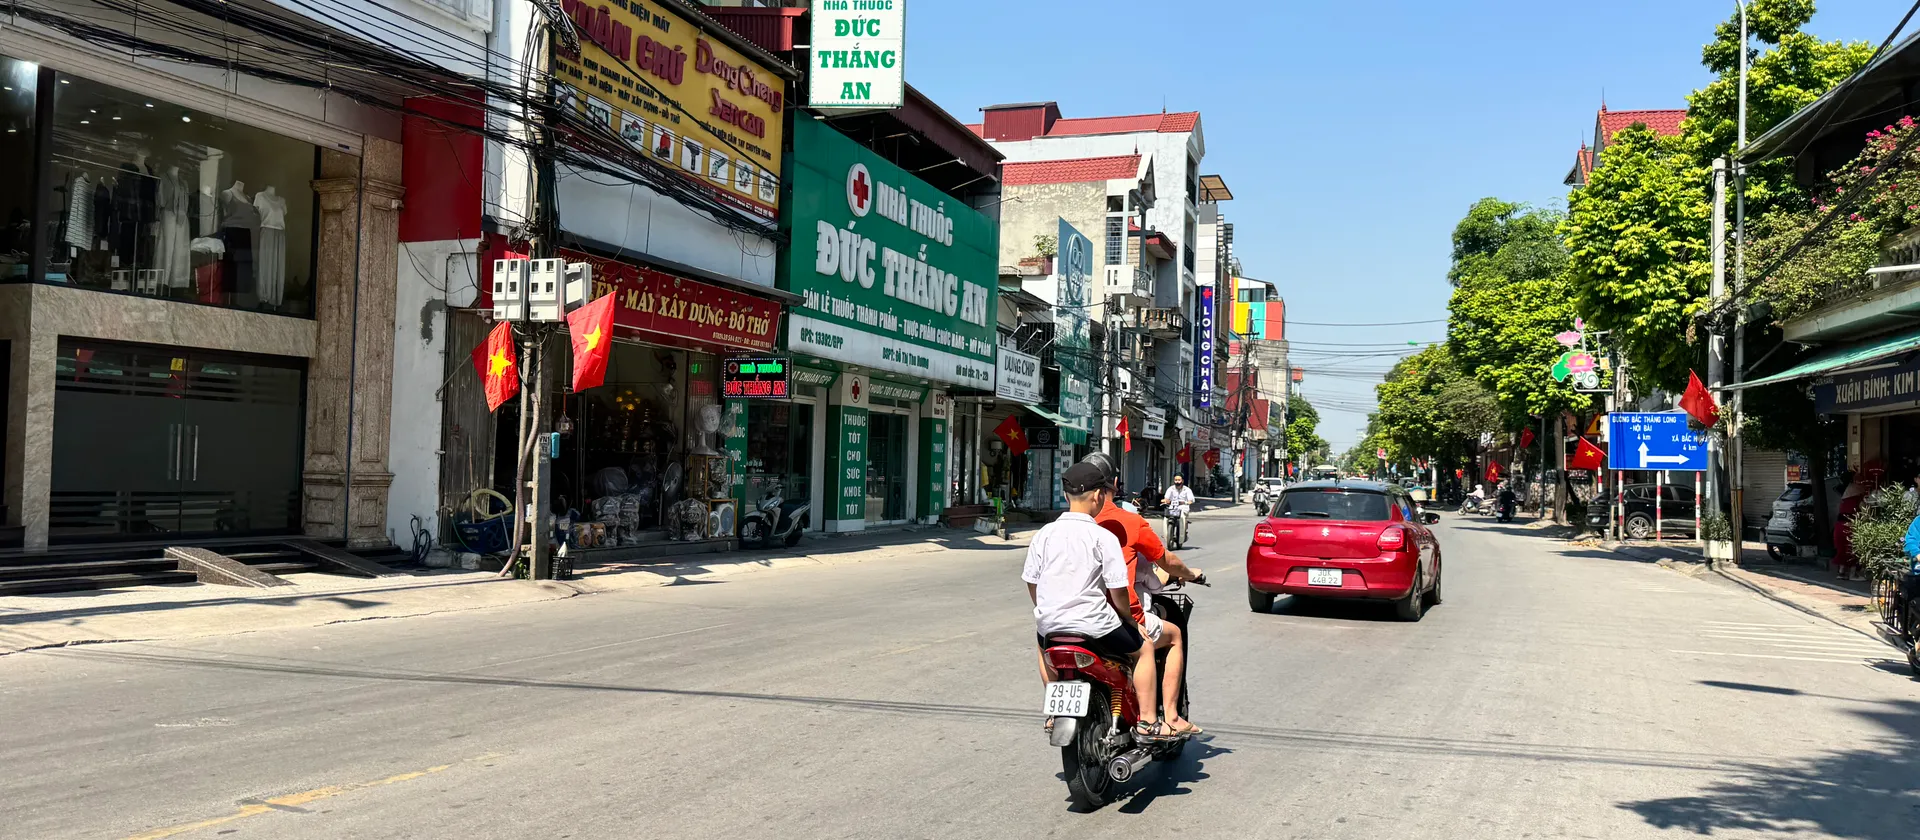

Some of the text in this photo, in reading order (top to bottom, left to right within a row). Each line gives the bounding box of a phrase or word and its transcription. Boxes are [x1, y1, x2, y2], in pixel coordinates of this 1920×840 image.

[630, 1, 651, 22] ĐIỆN
[652, 13, 670, 33] MÁY
[834, 14, 881, 37] ĐỨC
[636, 35, 688, 85] CHỨ
[818, 42, 896, 69] THẮNG
[583, 57, 599, 73] KINH
[621, 74, 635, 89] MÁY
[840, 81, 872, 100] AN
[875, 181, 954, 247] NHÀ THUỐC
[815, 219, 989, 327] ĐỨC THẮNG AN
[624, 285, 655, 313] MÁY
[657, 292, 688, 320] XÂY
[688, 303, 724, 328] DỰNG
[803, 287, 819, 311] BÁN
[821, 289, 830, 313] LẺ
[831, 294, 855, 320] THUỐC
[856, 303, 878, 327] THÀNH
[879, 307, 898, 333] PHẨM
[800, 327, 814, 344] GPS:
[1201, 306, 1212, 351] LONG
[757, 359, 783, 374] THUỐC
[725, 376, 743, 396] ĐỨC
[743, 374, 772, 396] THẮNG
[772, 380, 786, 396] AN
[1893, 371, 1914, 395] KIM
[843, 413, 866, 427] THUỐC
[848, 430, 861, 444] TỐT
[1682, 443, 1697, 451] 4 km
[846, 450, 861, 462] CHO
[846, 466, 861, 480] SỨC
[845, 501, 859, 515] TỐT
[1051, 684, 1082, 698] 29-U5
[1049, 699, 1081, 714] 9848
